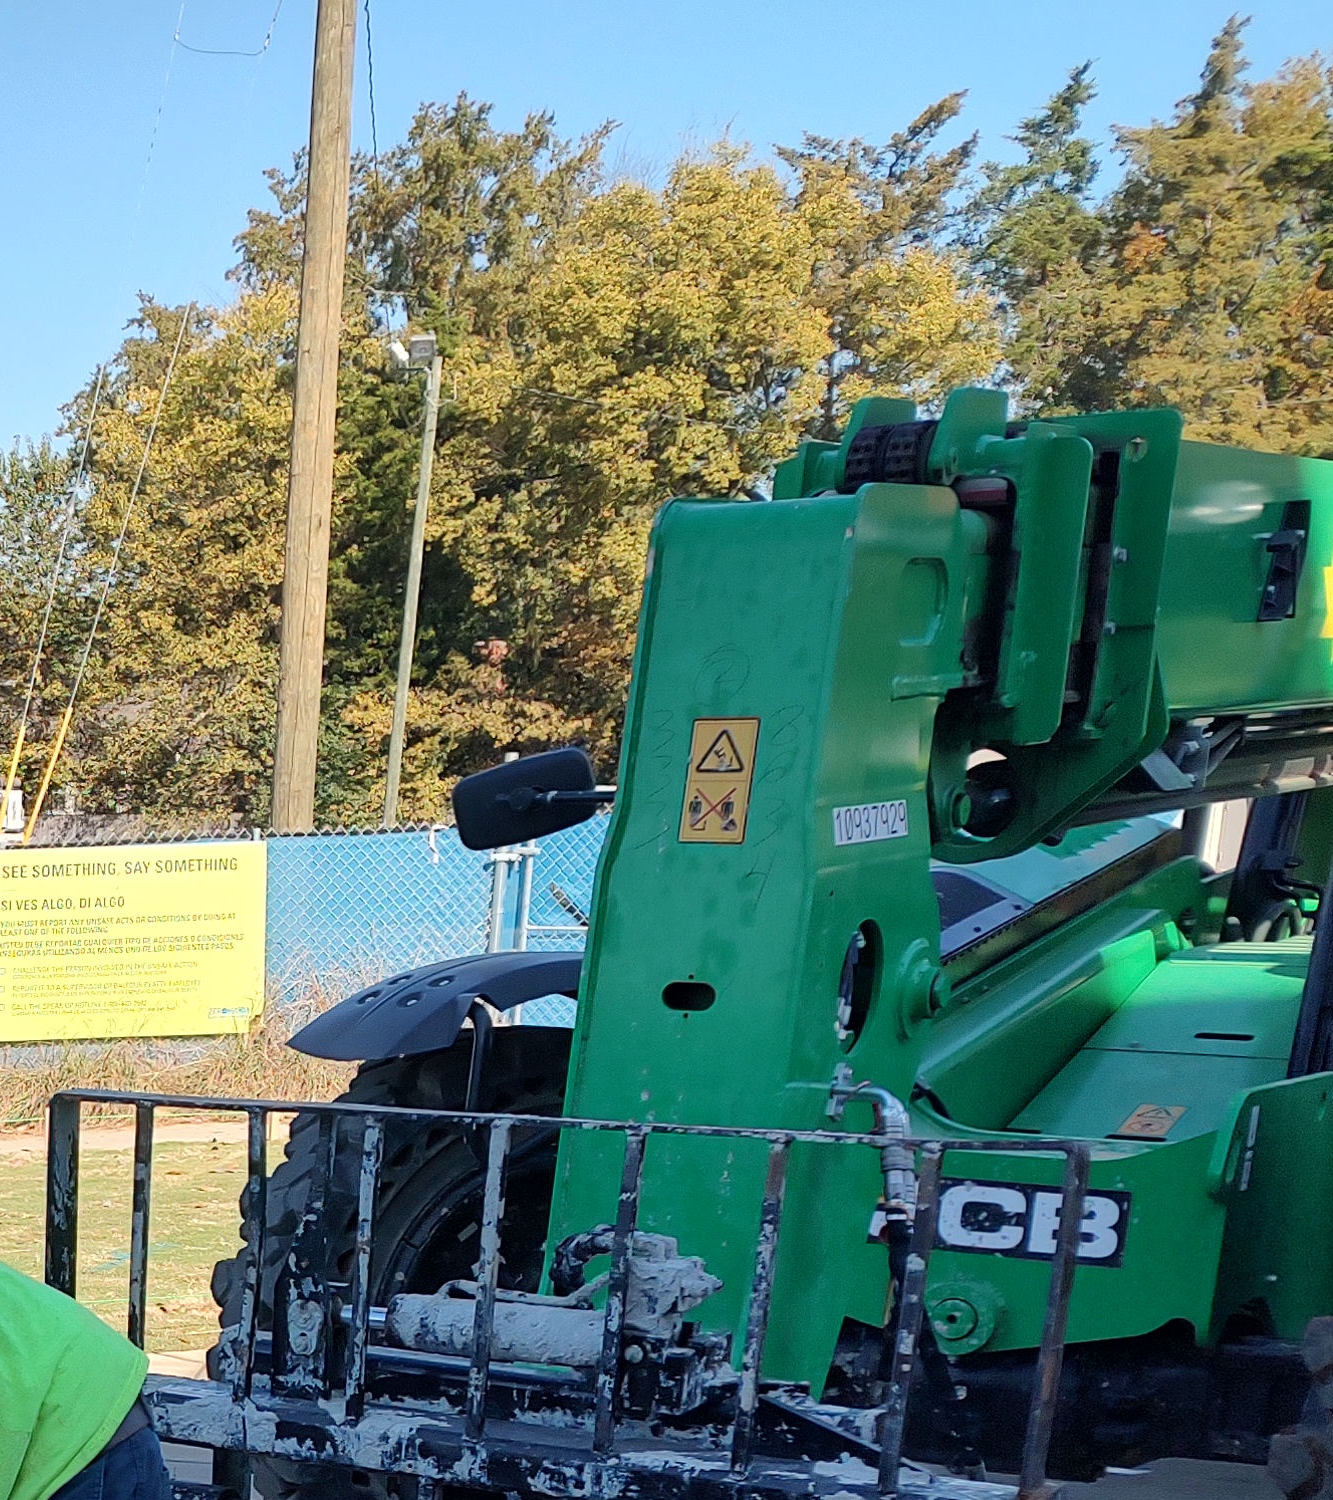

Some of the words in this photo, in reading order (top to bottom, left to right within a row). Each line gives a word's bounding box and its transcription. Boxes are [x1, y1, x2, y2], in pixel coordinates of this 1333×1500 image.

[836, 802, 907, 842] 10937929
[2, 865, 28, 879] SEE
[32, 862, 120, 878] SOMETHING,
[124, 861, 151, 875] SAY
[155, 858, 238, 873] SOMETHING
[1, 900, 12, 911] SI
[16, 899, 38, 911] VES
[41, 898, 76, 910] ALGO,
[80, 897, 91, 908] DI
[95, 896, 125, 908] ALGO
[40, 919, 66, 927] REPORT
[147, 915, 191, 923] CONDITIONS
[869, 1180, 1120, 1259] CB
